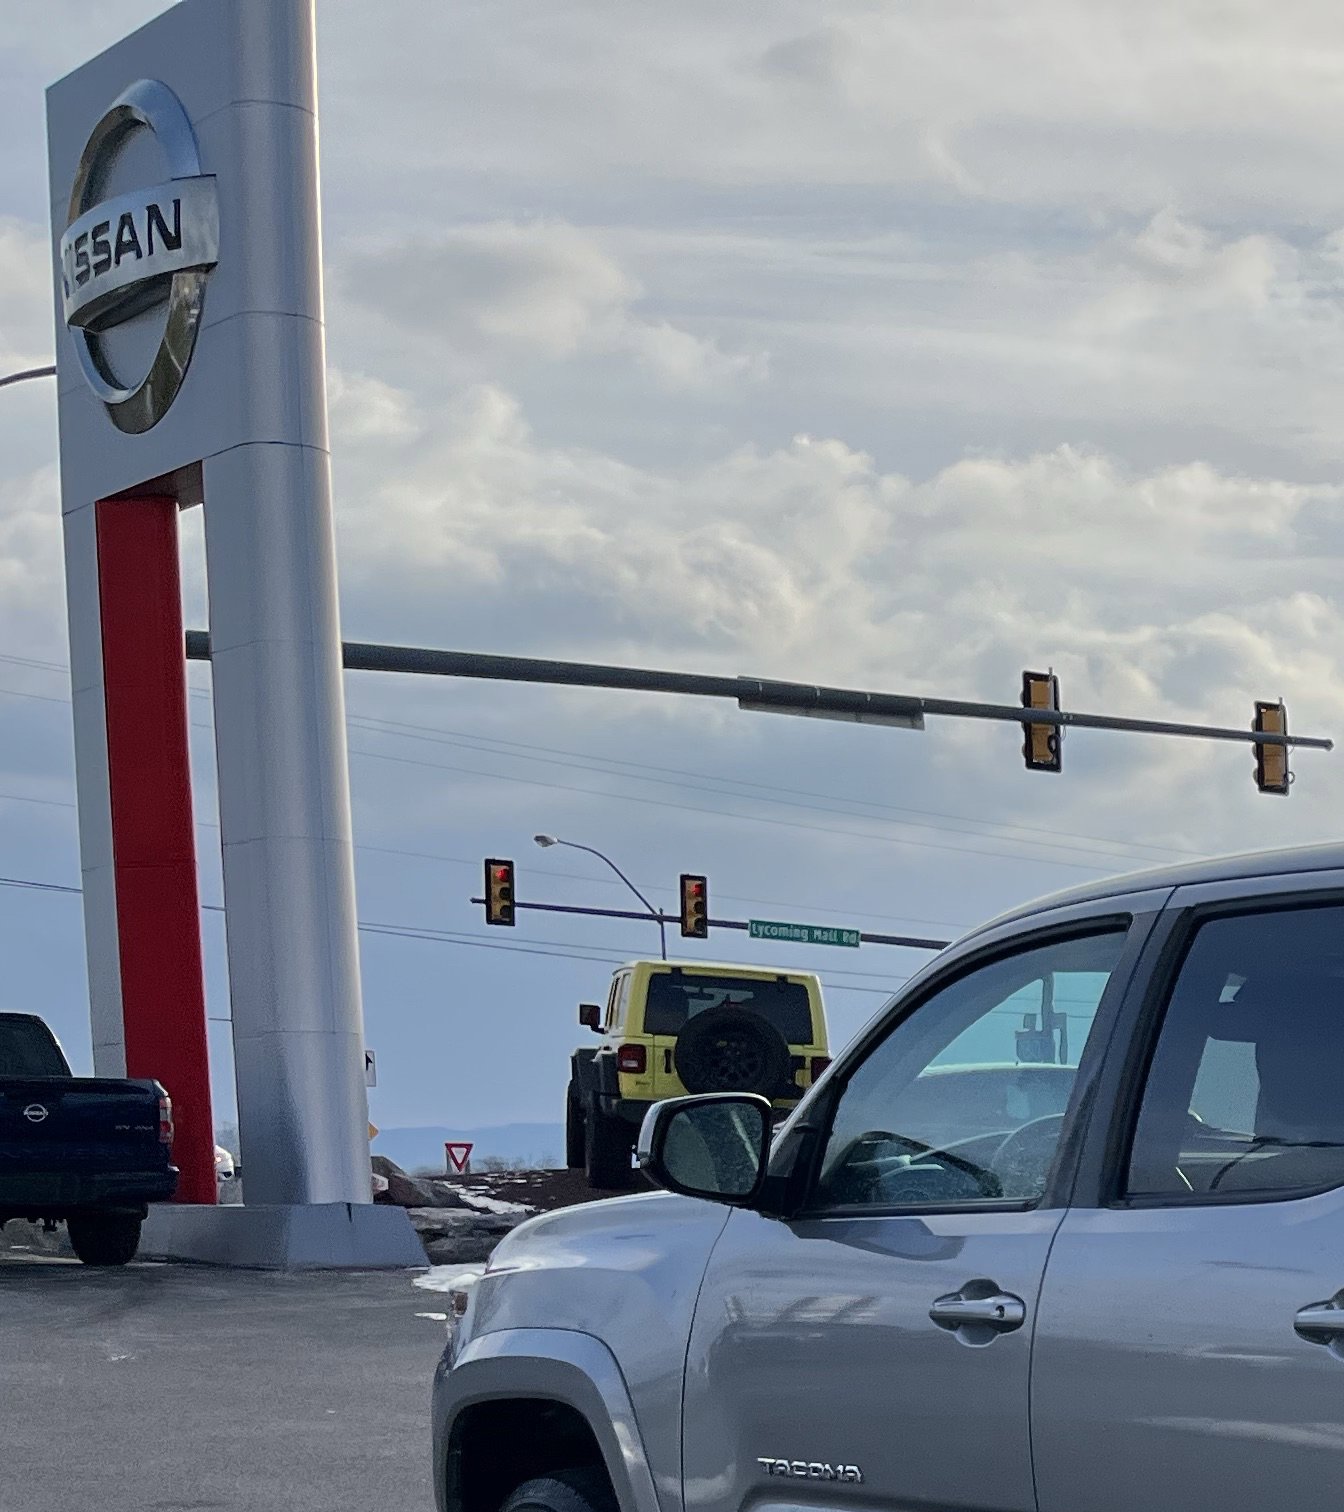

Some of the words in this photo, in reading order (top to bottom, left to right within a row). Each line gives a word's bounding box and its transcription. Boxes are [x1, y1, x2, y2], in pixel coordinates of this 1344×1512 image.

[751, 922, 809, 942] Lycoming
[813, 928, 839, 943] Mall
[842, 930, 858, 945] Rd
[756, 1456, 865, 1484] TACOMA
